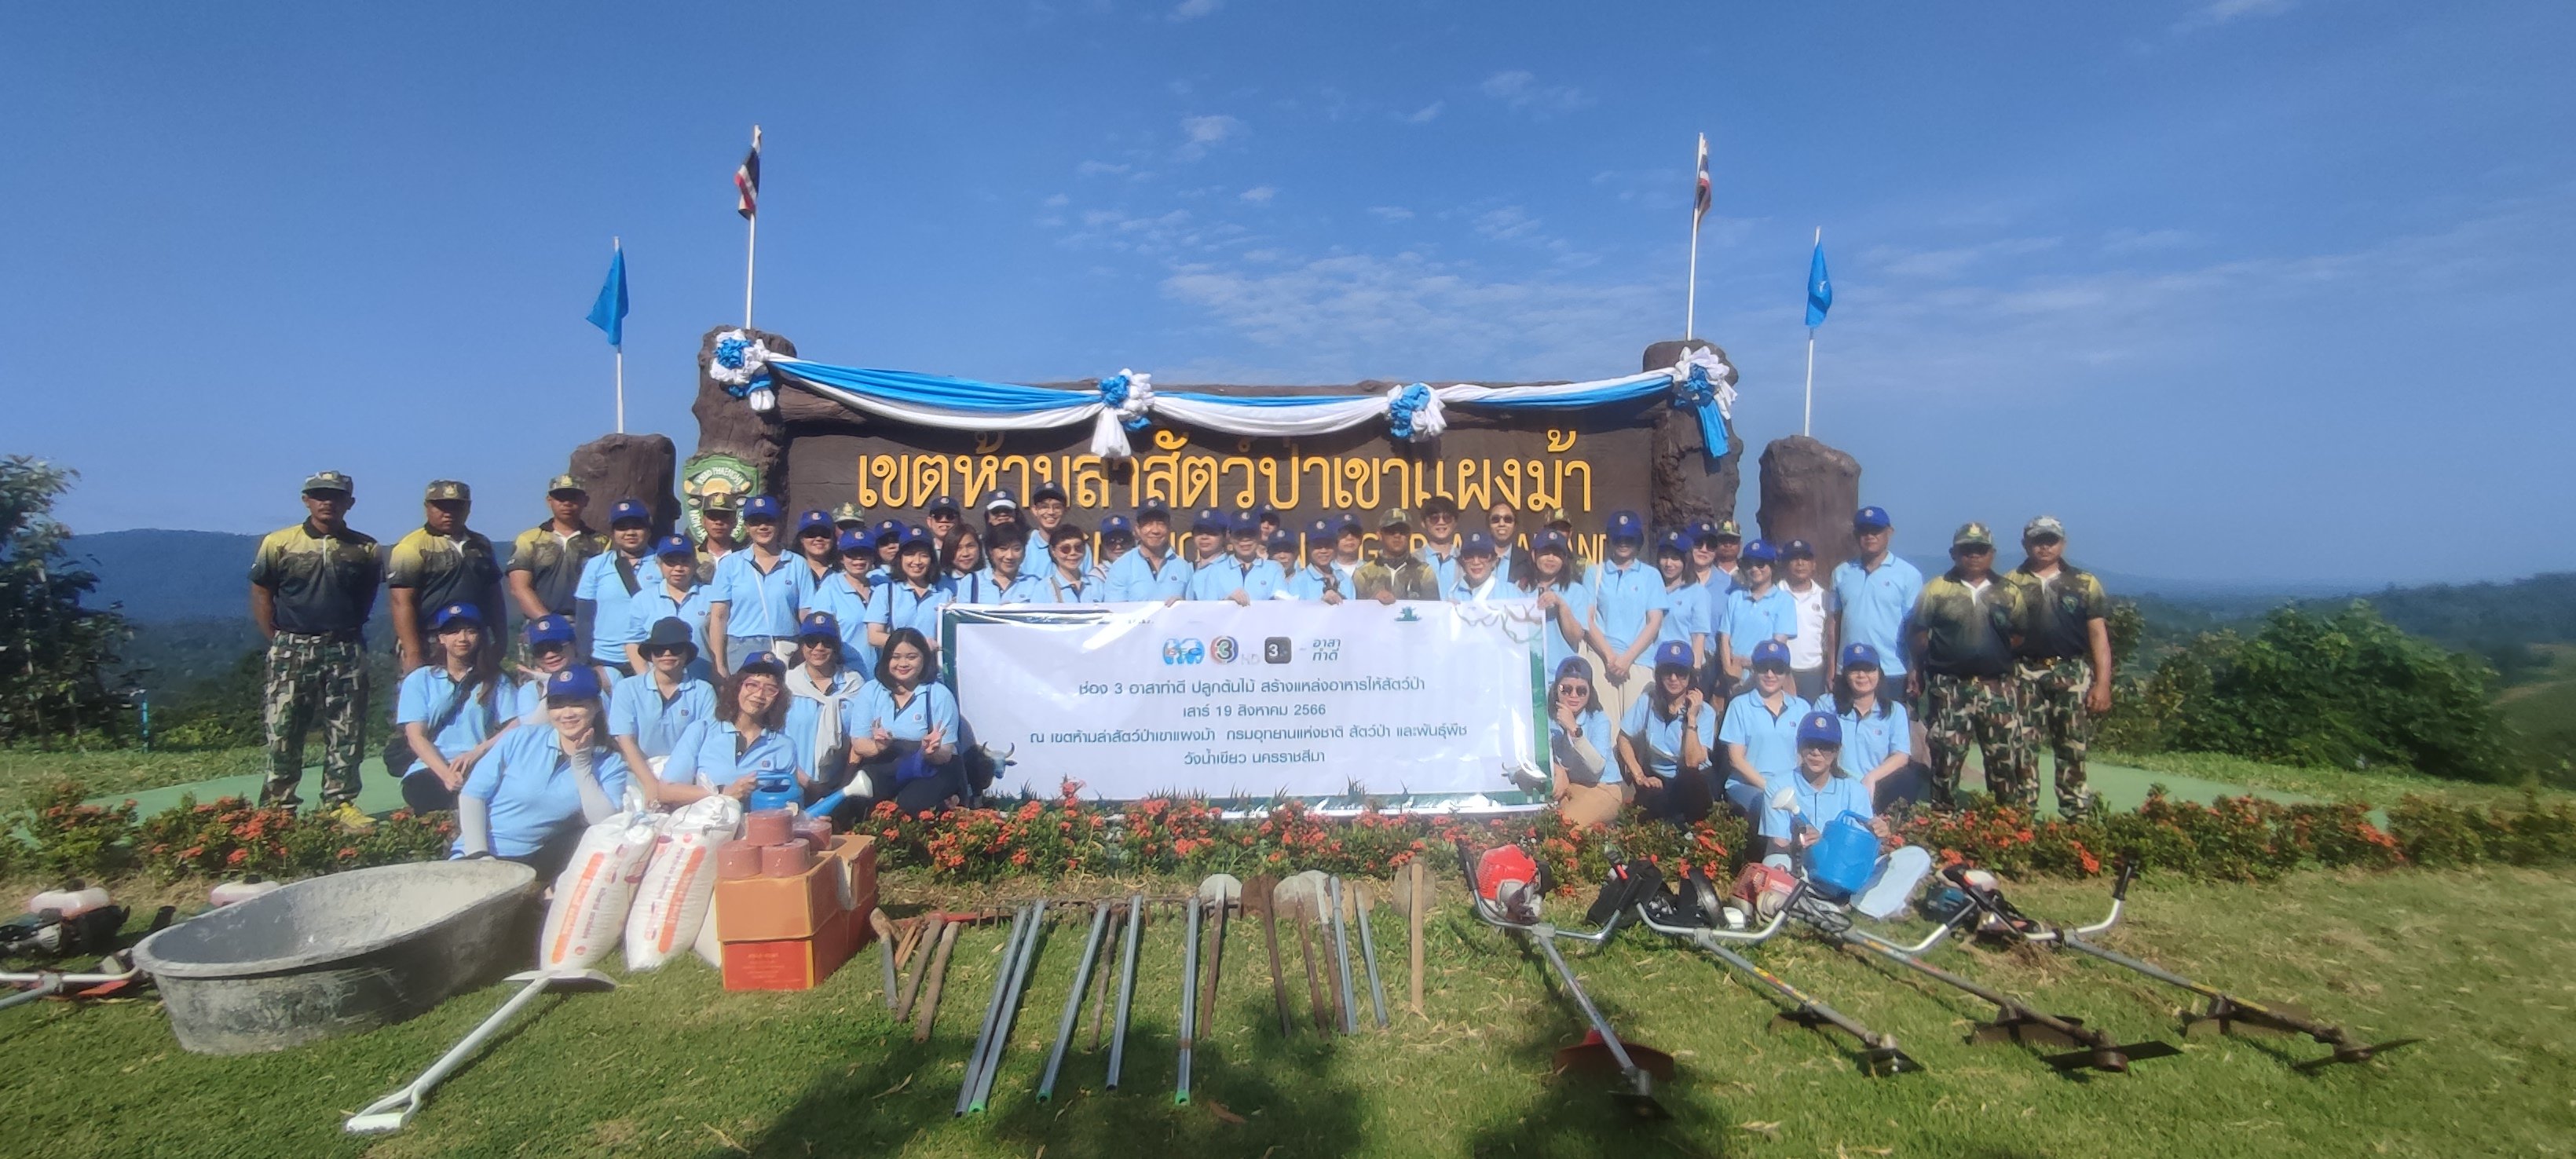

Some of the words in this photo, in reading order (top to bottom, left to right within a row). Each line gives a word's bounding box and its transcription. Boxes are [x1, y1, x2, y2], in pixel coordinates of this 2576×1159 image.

[1312, 638, 1341, 649] อาสา
[1312, 648, 1339, 662] ทำดี
[1079, 680, 1108, 696] ช่อง
[1114, 682, 1123, 695] 3
[1129, 679, 1185, 695] อาสาทำดี
[1192, 678, 1257, 697] ปลูกต้นไม้
[1261, 675, 1425, 693] สร้างแหล่งอาหารให้สัตว์ป่า
[1183, 703, 1210, 718] เสาร์
[1216, 704, 1232, 717] 19
[1237, 704, 1288, 717] สิงหาคม
[1293, 703, 1326, 716] 2566
[1030, 732, 1045, 744] ณ
[1051, 727, 1216, 744] เขตห้ามล่าสัตว์ป่าเขาแผงม้า
[1227, 725, 1344, 744] กรมอุทยานแห่งชาติ
[1348, 722, 1391, 738] สัตว์ป่า
[1396, 722, 1468, 740] และพันธุ์พืช
[1184, 748, 1247, 766] วังน้ำเขียว
[1252, 748, 1326, 764] นครราชสีมา
